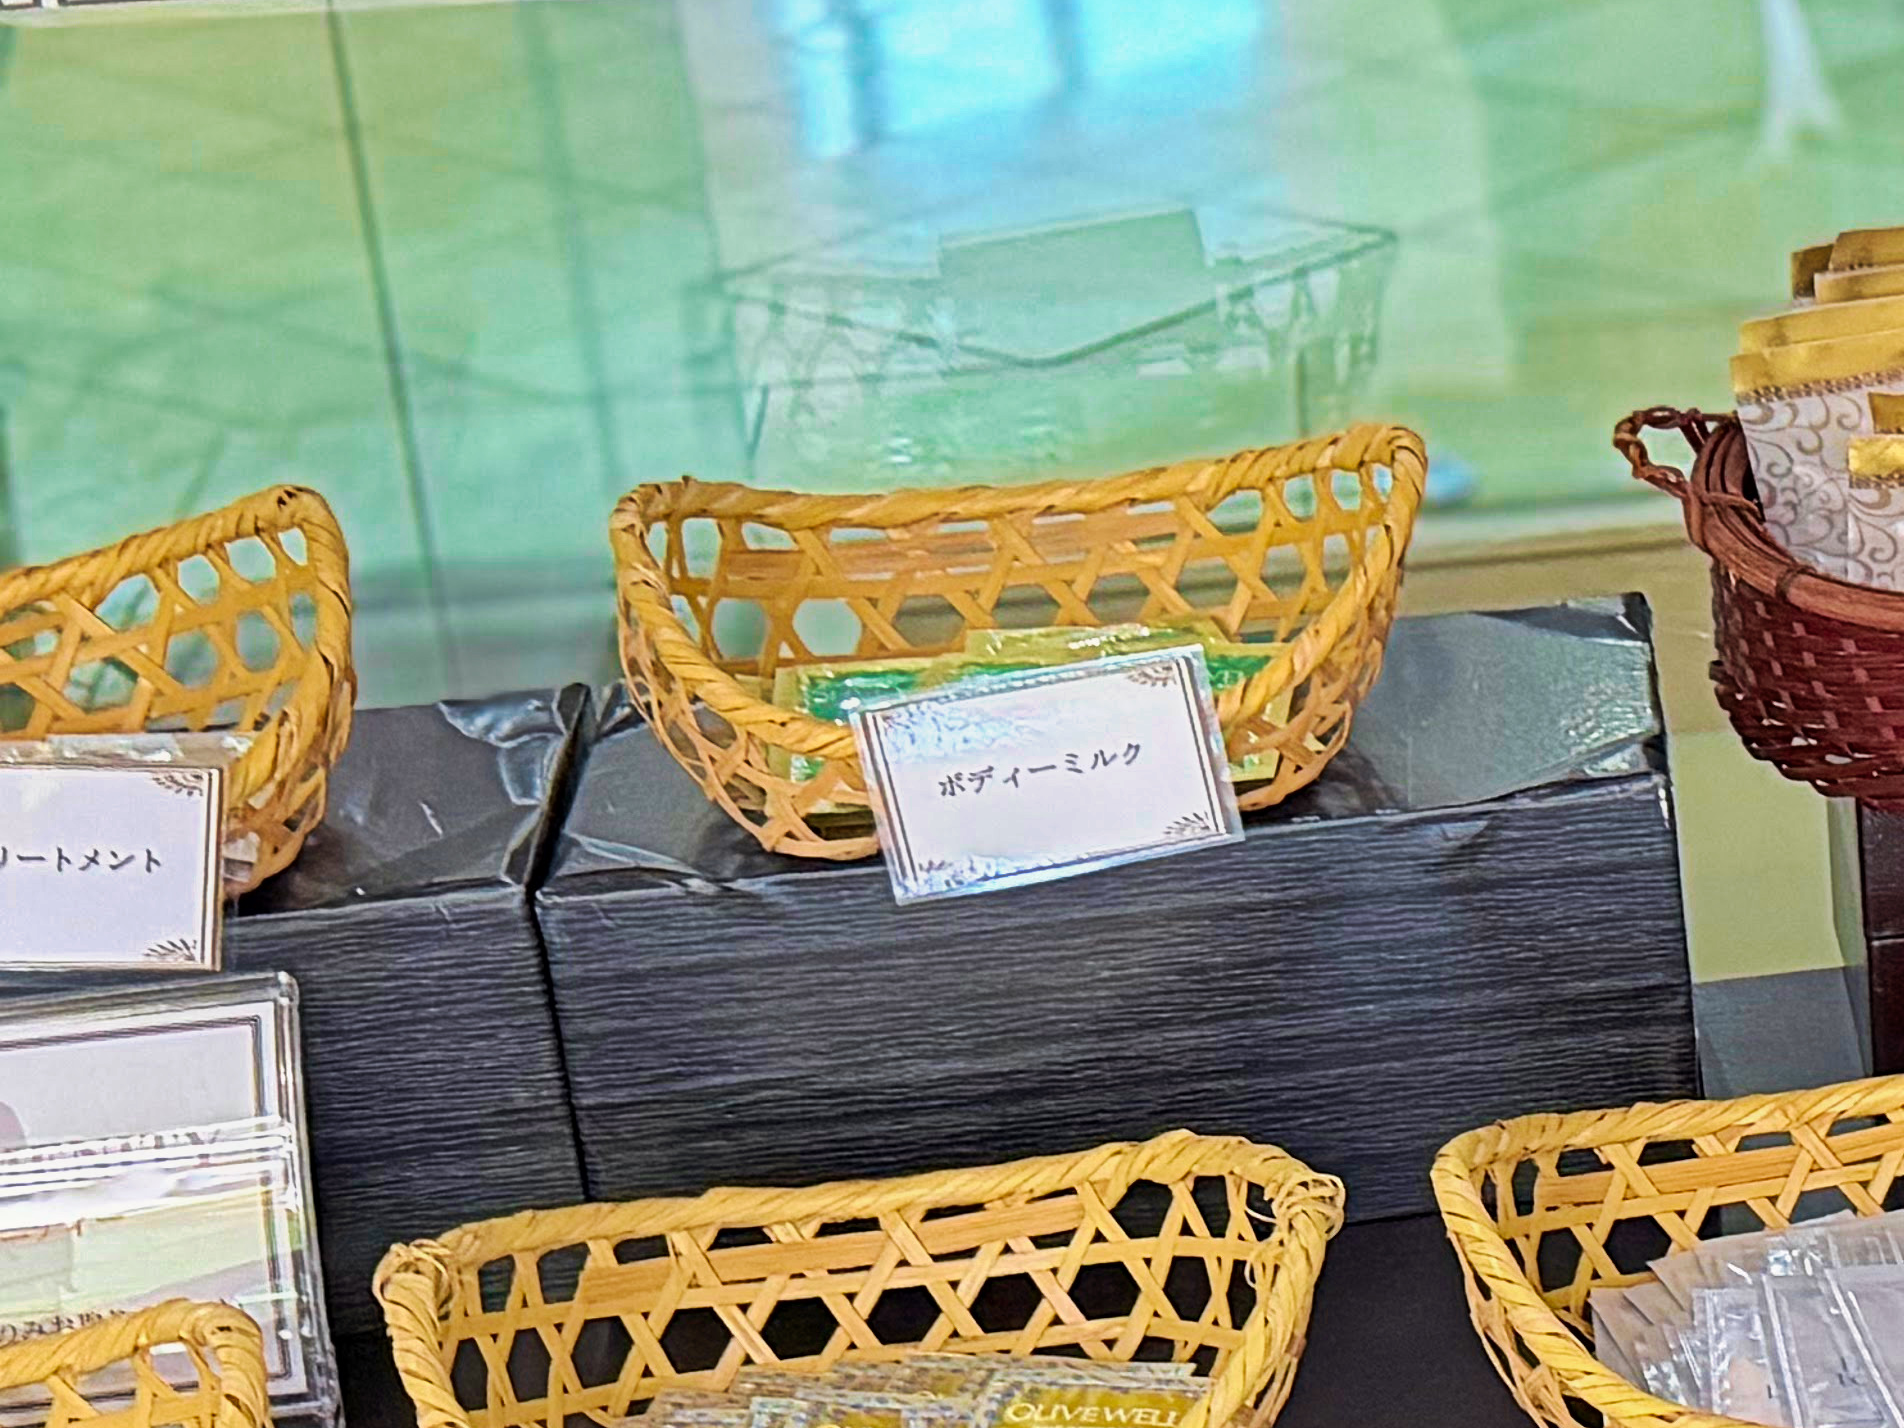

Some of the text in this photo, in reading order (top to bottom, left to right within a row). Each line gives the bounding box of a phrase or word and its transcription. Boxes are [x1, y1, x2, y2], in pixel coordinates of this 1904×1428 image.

[938, 741, 1141, 797] ボディーミルク
